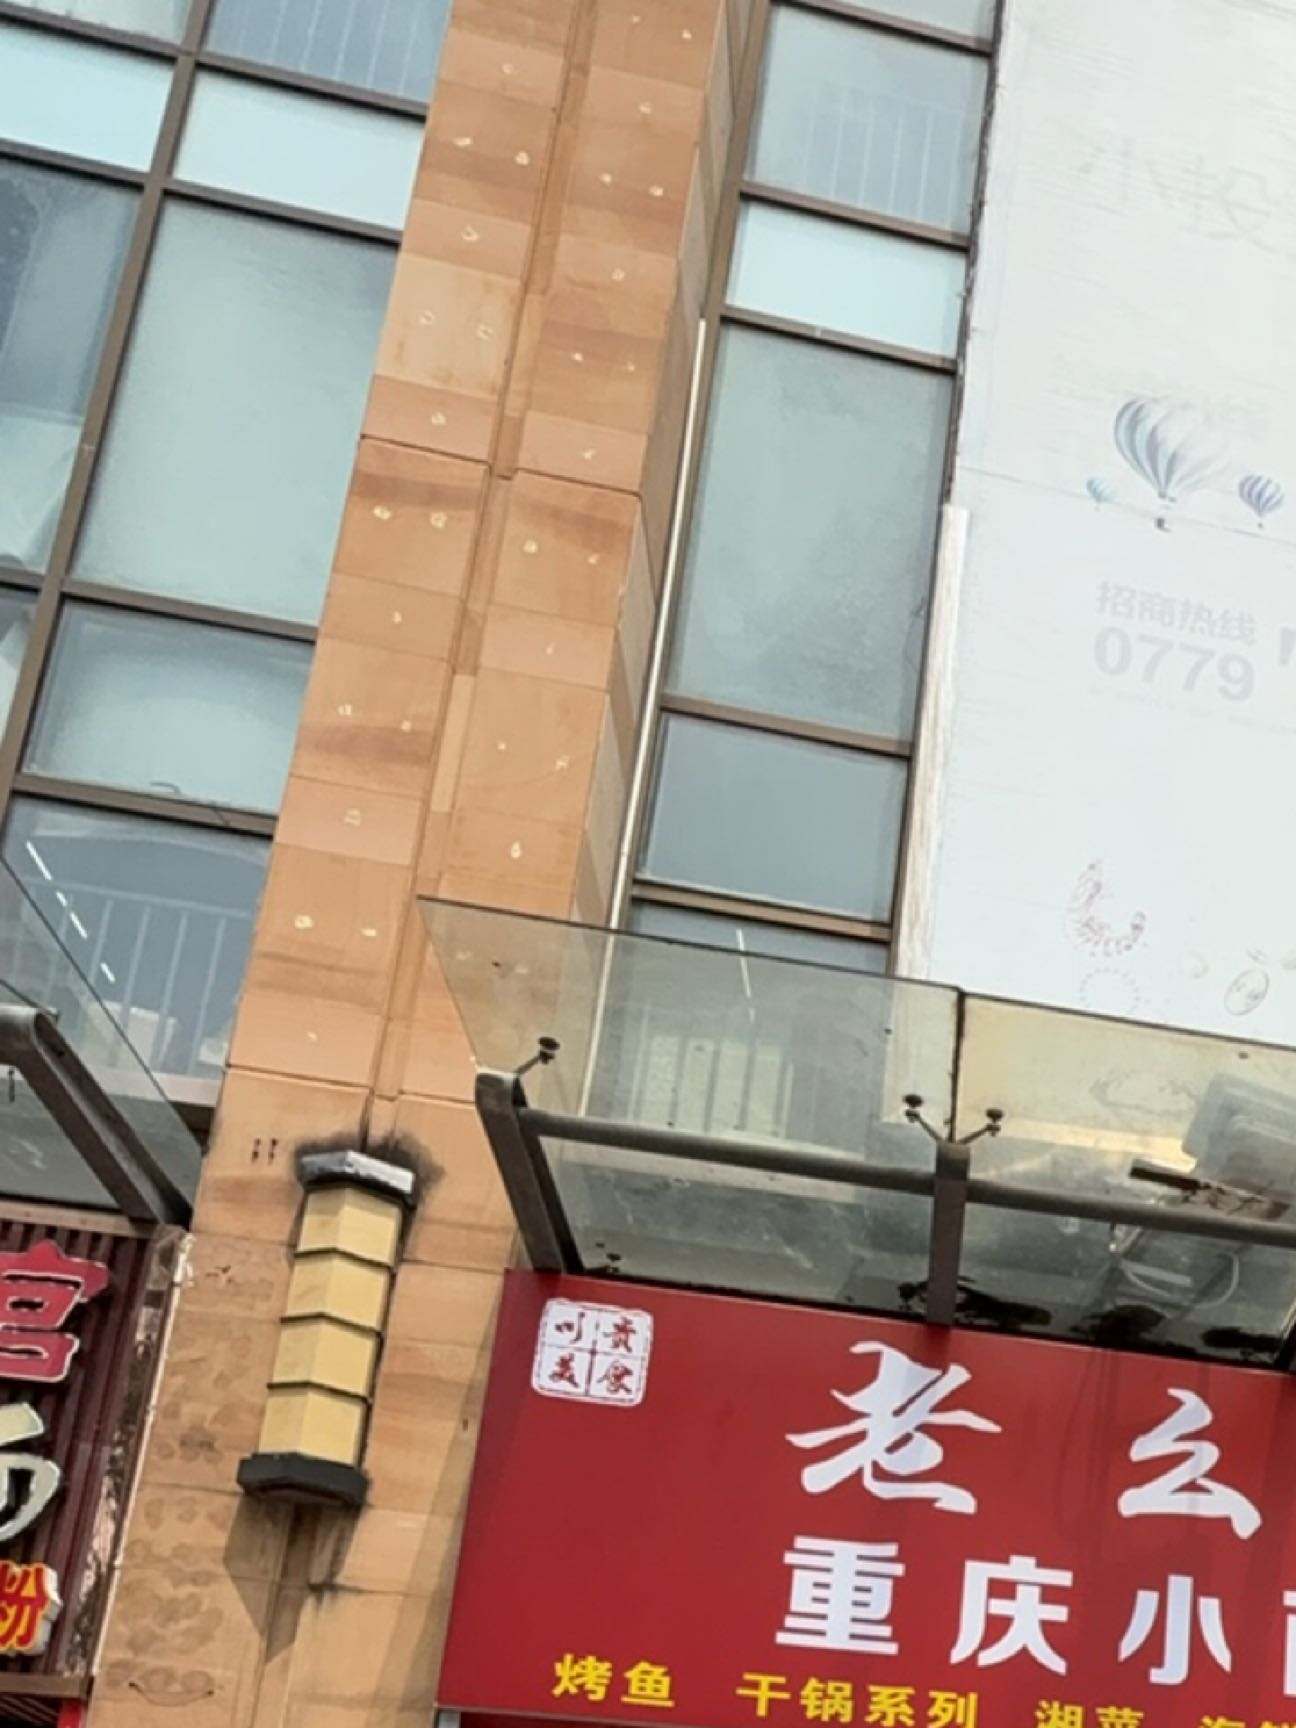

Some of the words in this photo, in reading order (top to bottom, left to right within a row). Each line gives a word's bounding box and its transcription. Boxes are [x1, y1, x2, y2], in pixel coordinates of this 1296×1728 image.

[1096, 582, 1255, 646] 招商热线
[1094, 627, 1254, 700] 0779
[554, 1653, 675, 1709] 烤鱼
